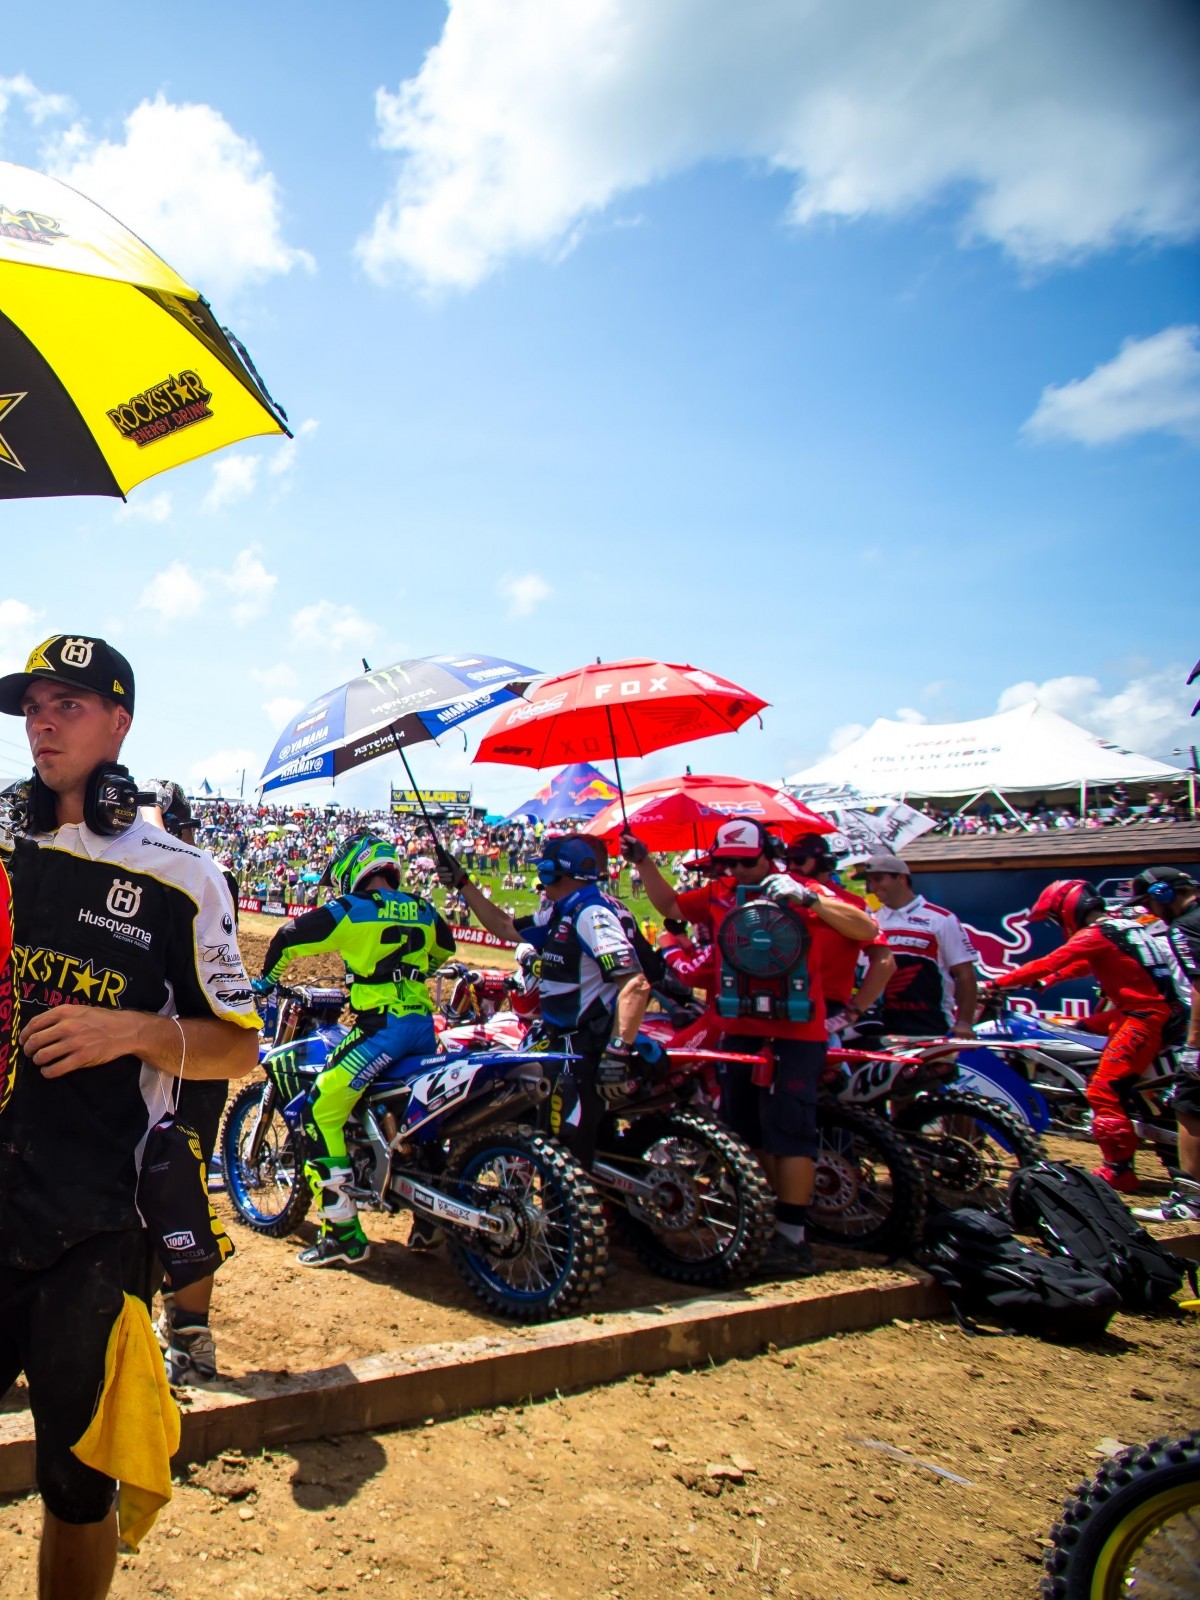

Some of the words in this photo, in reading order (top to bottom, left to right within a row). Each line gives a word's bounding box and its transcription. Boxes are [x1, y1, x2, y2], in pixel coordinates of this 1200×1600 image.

[595, 676, 668, 700] FOX
[290, 726, 329, 753] YAMAHA
[153, 841, 201, 858] DUNLOP
[247, 900, 259, 911] OIL
[78, 908, 152, 944] Husqvarna
[452, 928, 483, 943] LUCAS
[372, 925, 427, 977] 2
[361, 1052, 393, 1082] YAMAHA
[168, 1235, 191, 1247] 100%
